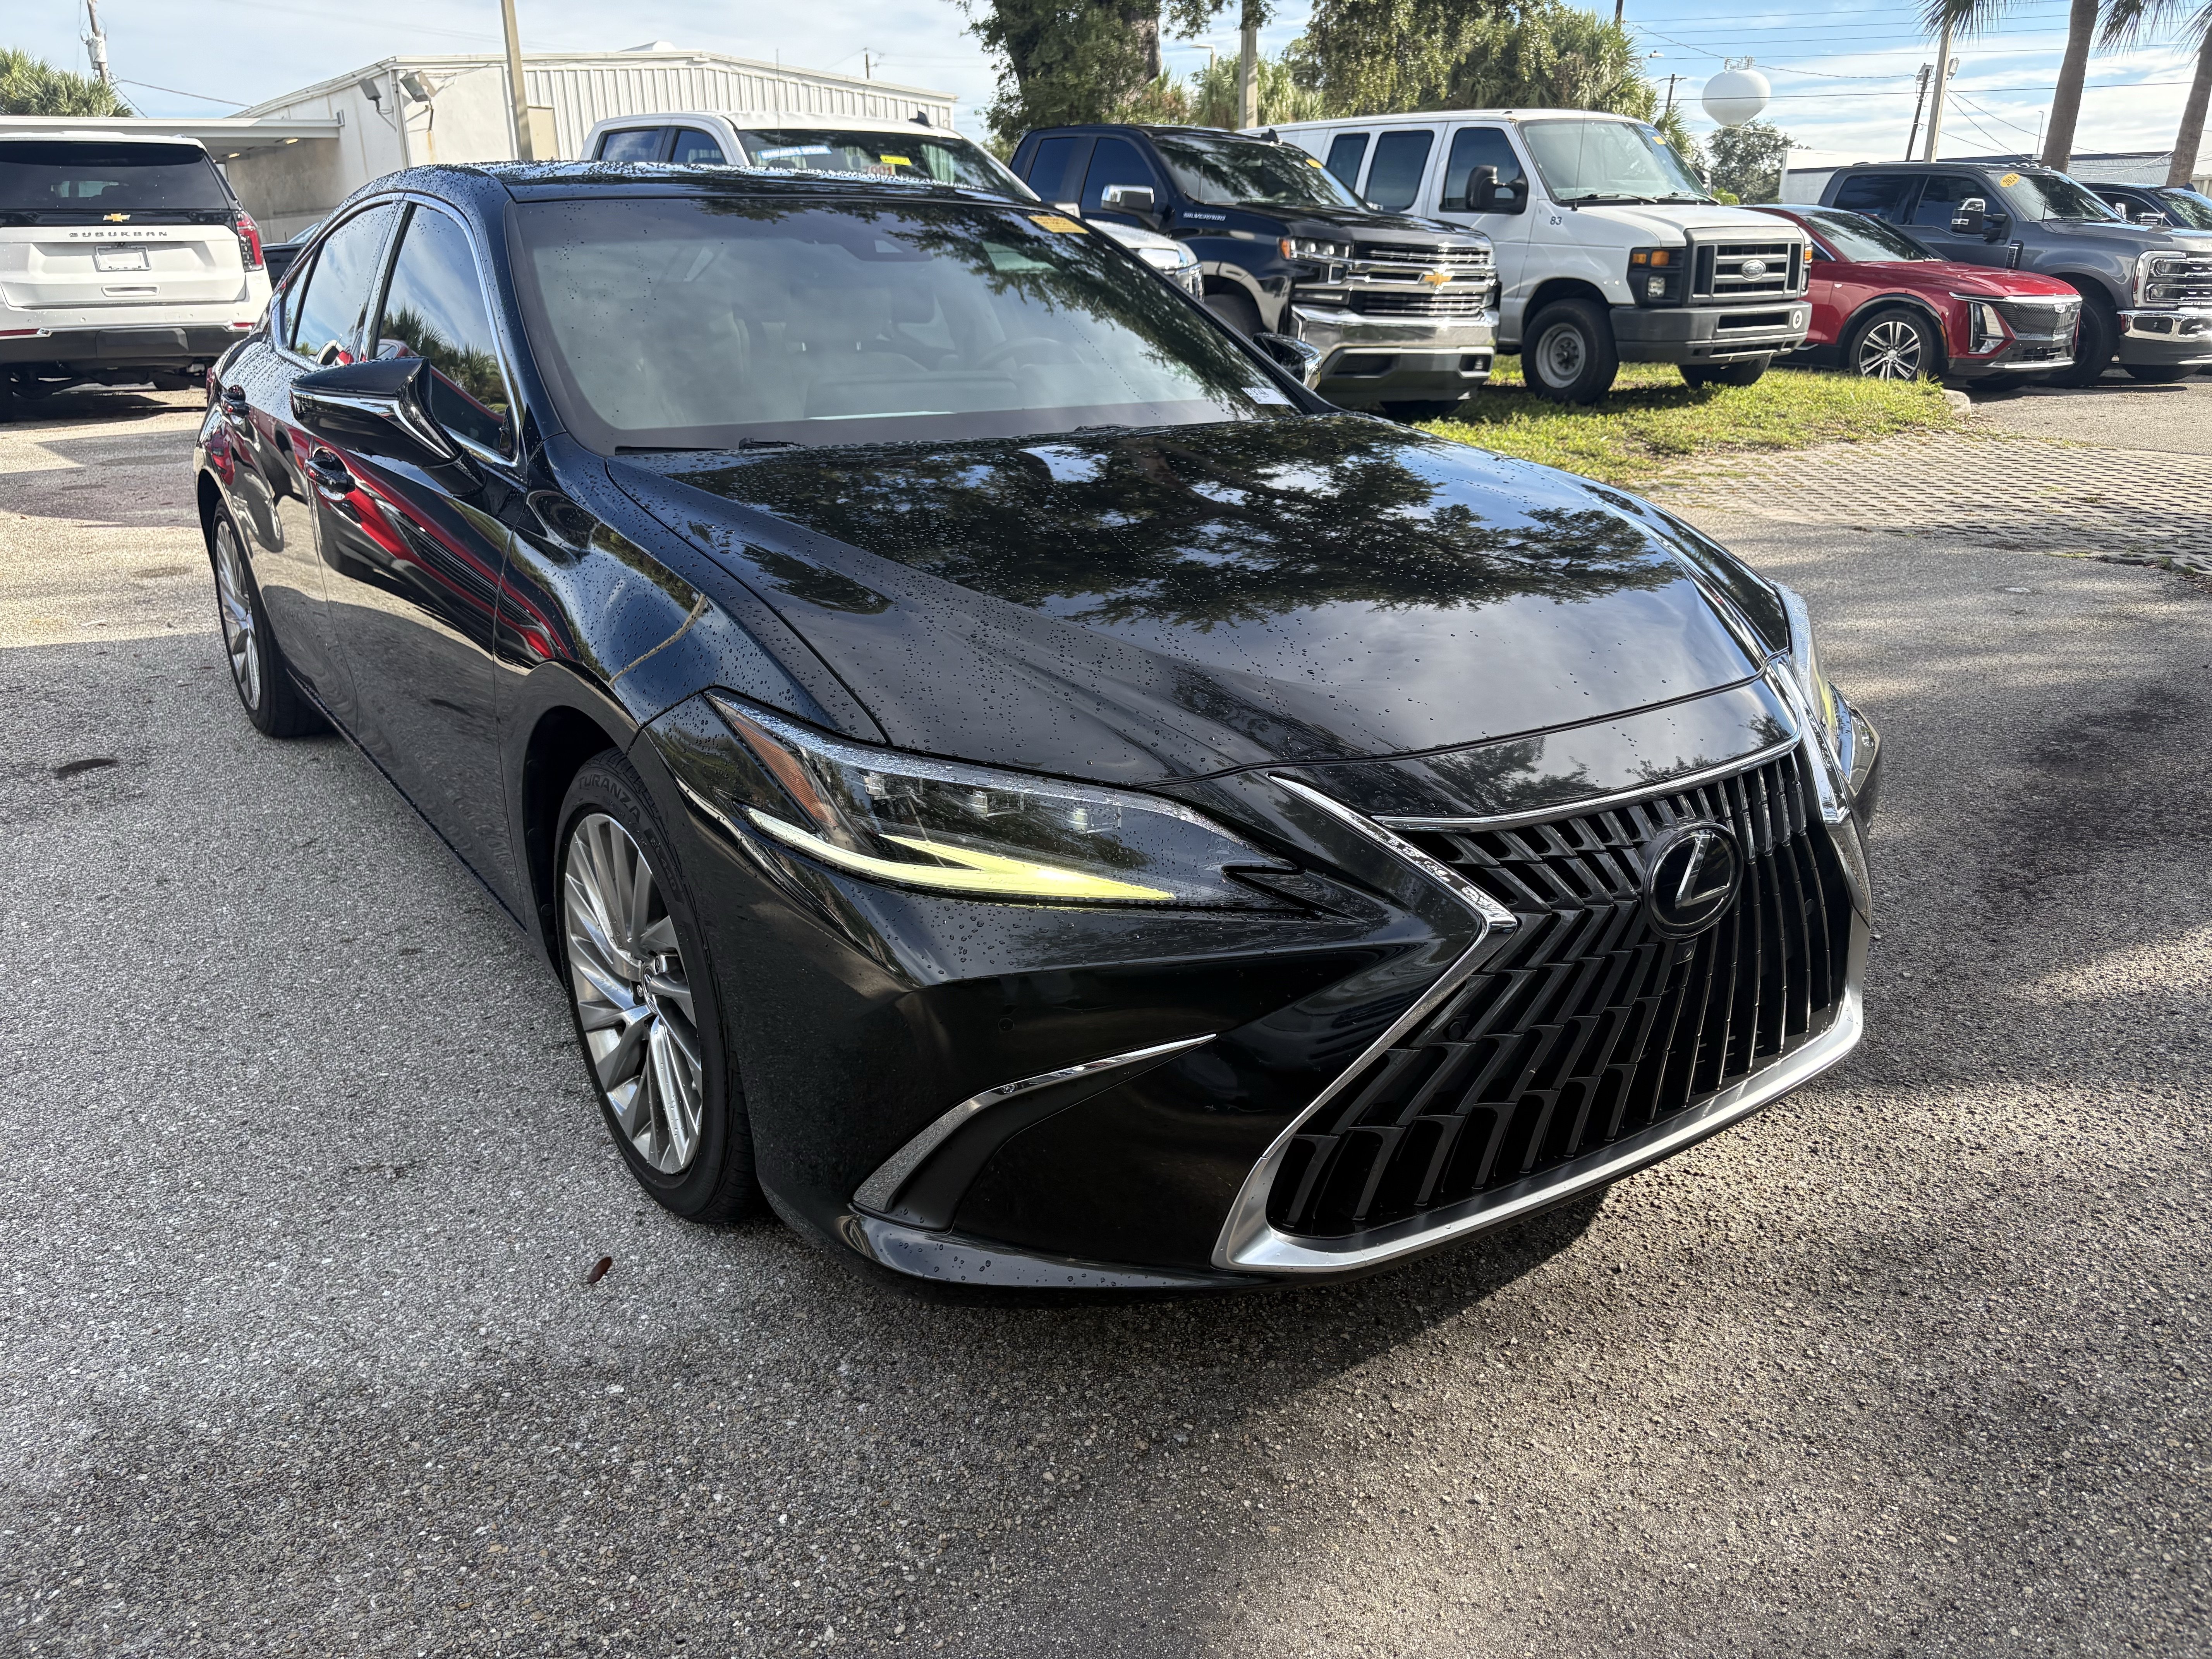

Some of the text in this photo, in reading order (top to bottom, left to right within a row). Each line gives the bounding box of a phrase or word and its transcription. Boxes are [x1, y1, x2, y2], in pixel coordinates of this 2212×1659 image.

[2002, 174, 2017, 186] 2024
[1550, 216, 1562, 225] 83
[579, 774, 641, 823] TURANZA
